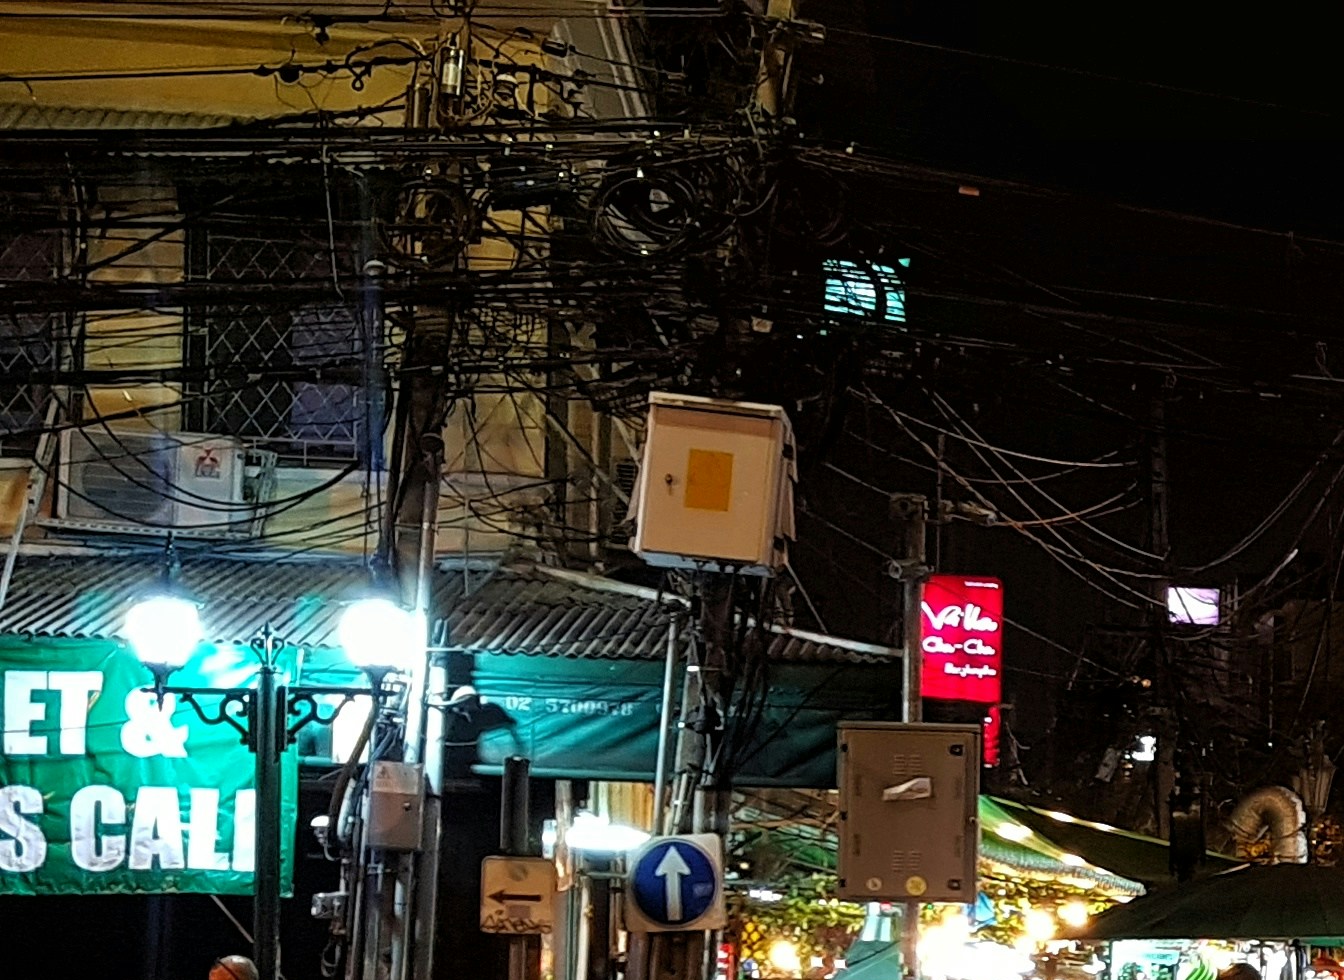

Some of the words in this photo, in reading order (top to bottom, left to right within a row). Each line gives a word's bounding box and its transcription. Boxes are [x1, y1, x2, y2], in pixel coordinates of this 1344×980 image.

[4, 670, 104, 755] ET
[120, 684, 188, 758] &
[506, 696, 530, 711] 02
